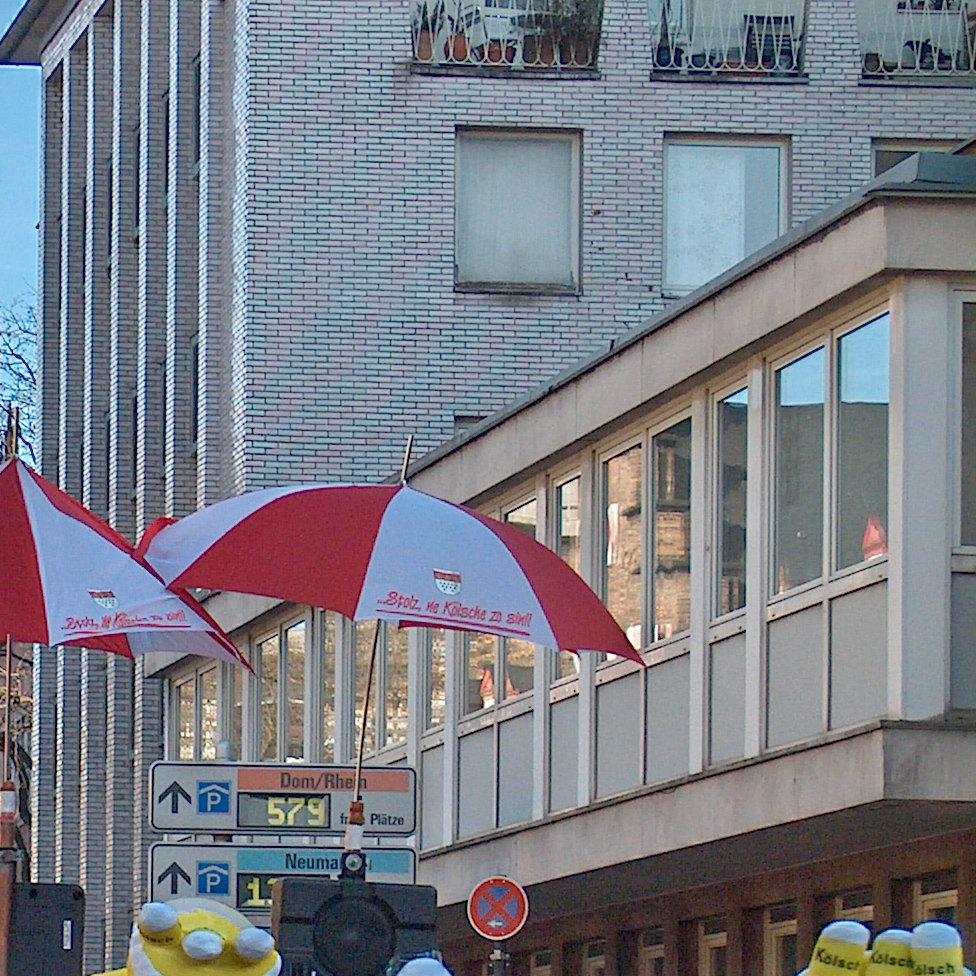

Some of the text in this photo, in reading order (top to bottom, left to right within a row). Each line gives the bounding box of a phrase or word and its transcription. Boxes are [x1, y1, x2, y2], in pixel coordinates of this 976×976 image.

[280, 772, 368, 790] Dom/Rhen
[266, 796, 326, 827] 579
[370, 813, 405, 826] Plätze
